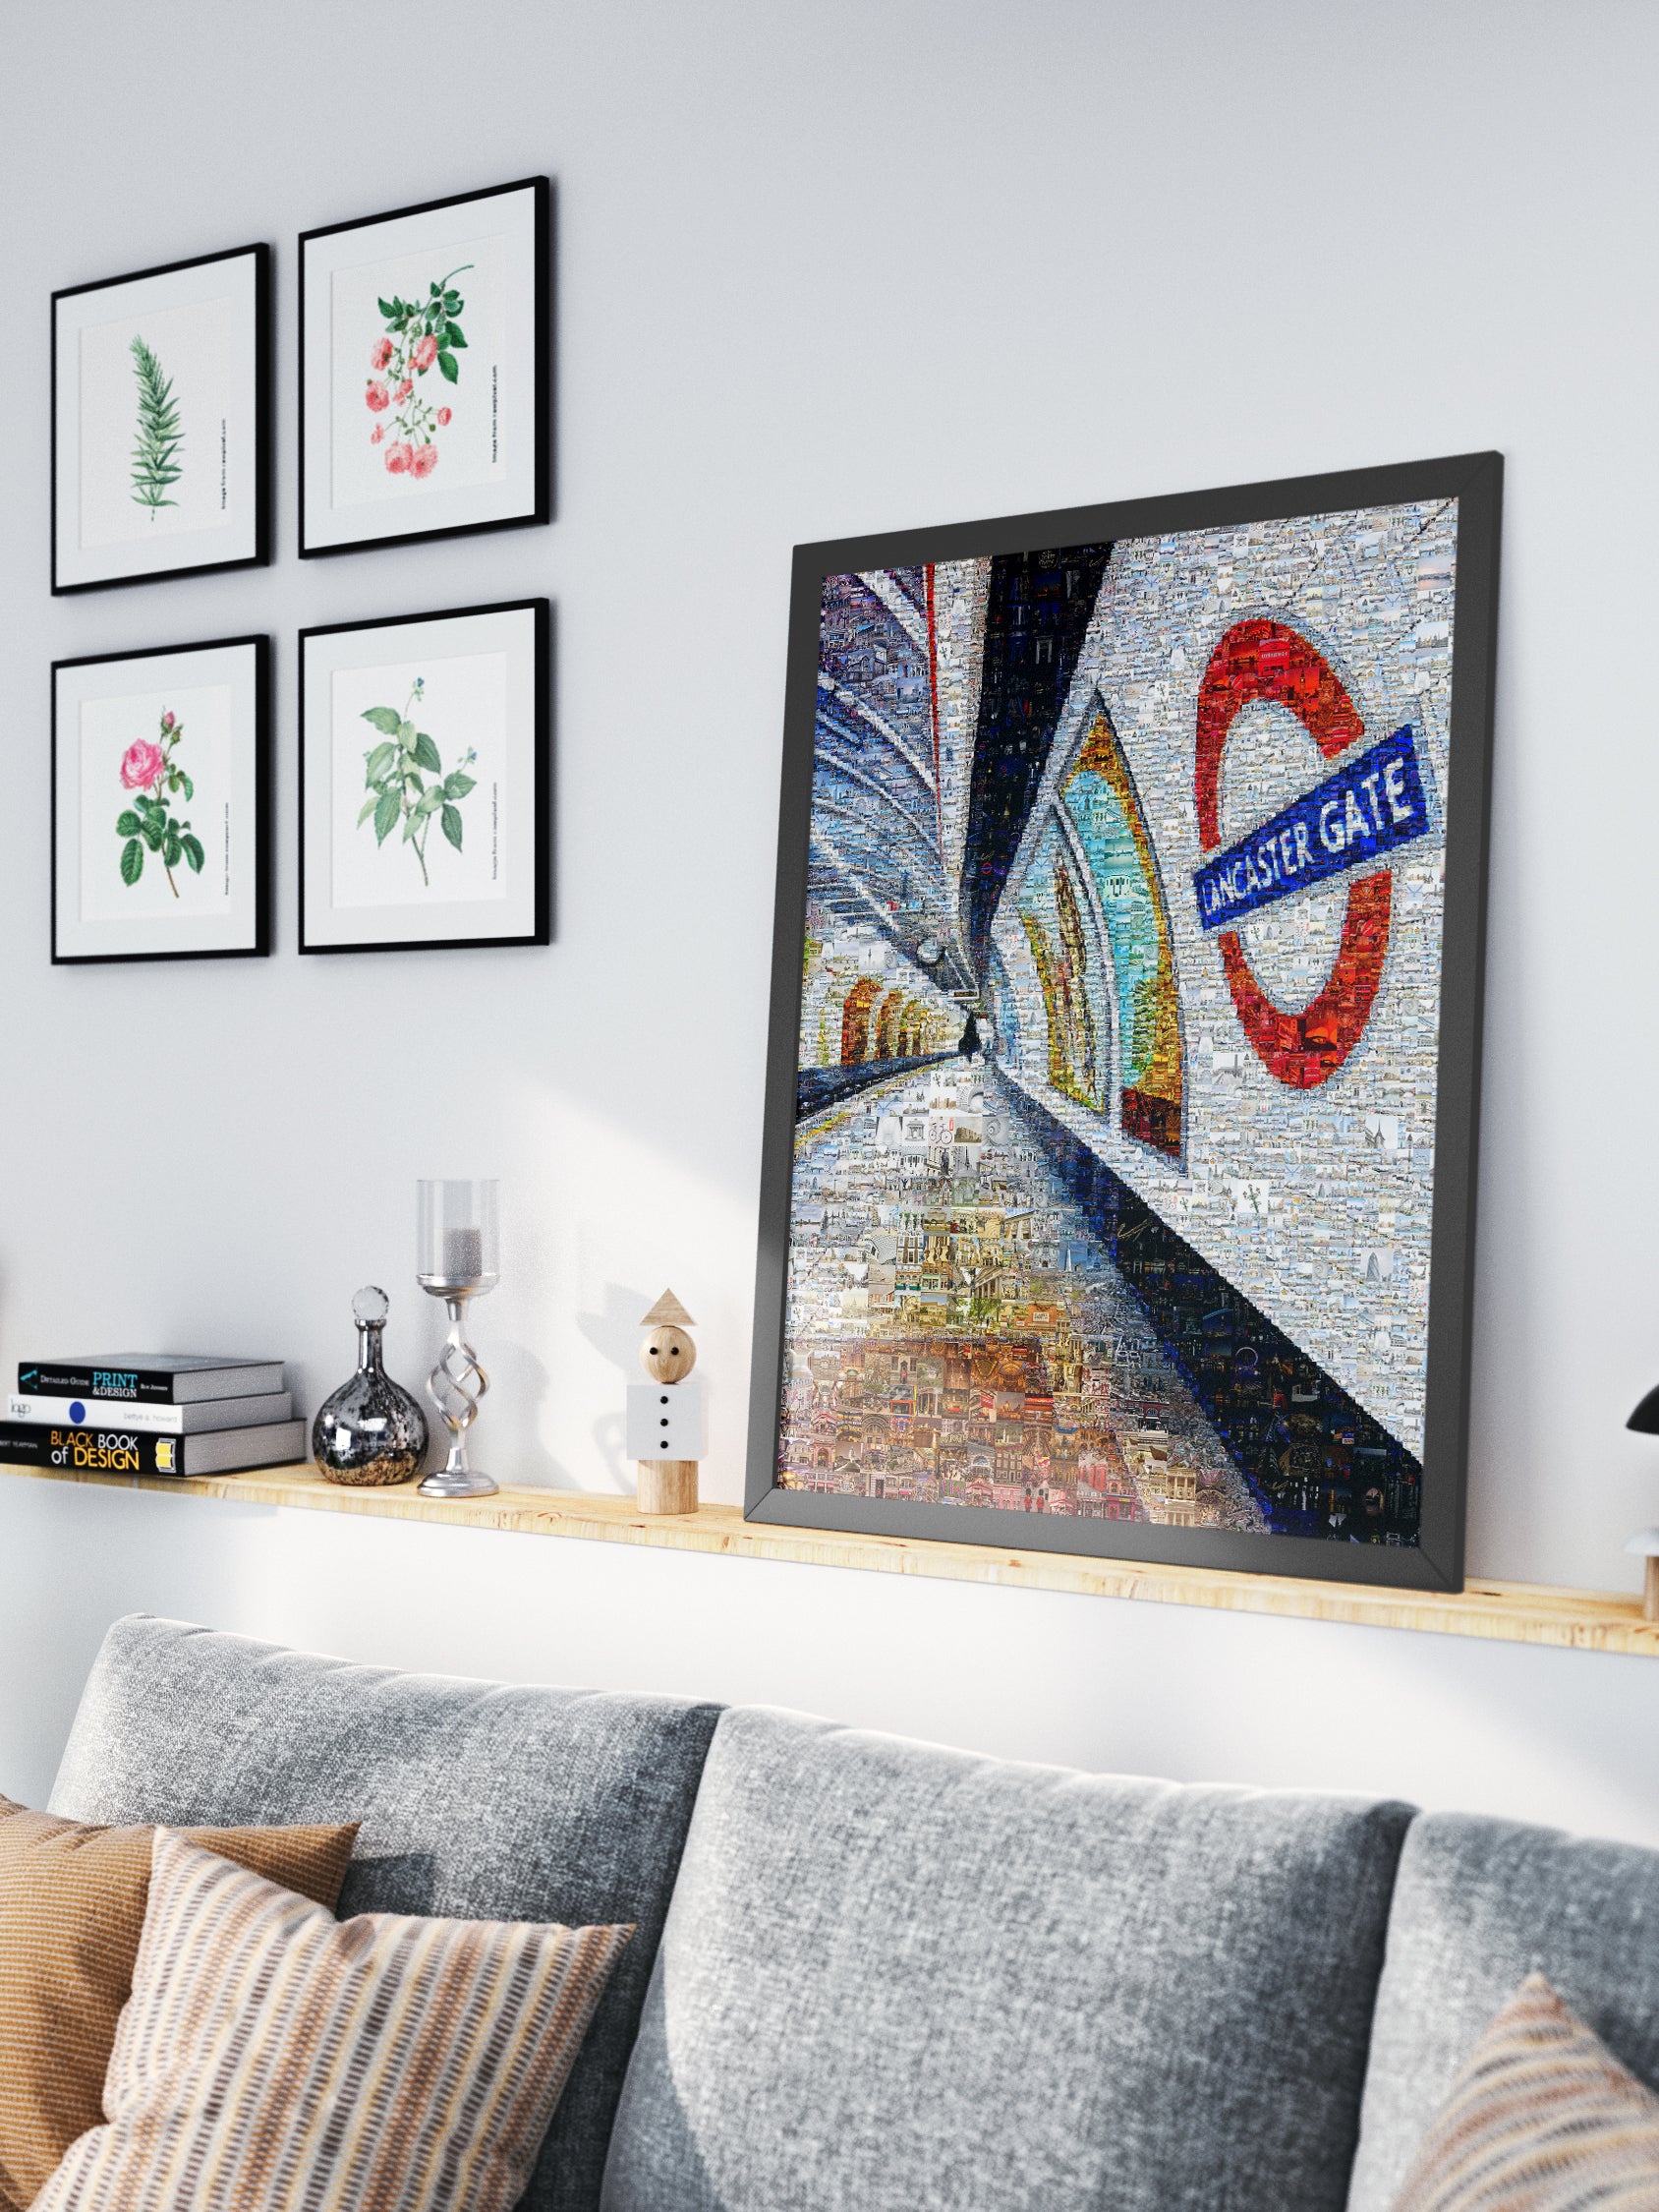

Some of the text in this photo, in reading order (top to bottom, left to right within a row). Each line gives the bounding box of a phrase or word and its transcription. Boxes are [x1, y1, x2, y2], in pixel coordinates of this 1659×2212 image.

[1319, 756, 1415, 854] GATE
[92, 1371, 139, 1389] PRINT
[91, 1385, 138, 1398] &DESIGN
[10, 1398, 32, 1419] logo
[50, 1430, 139, 1451] BLACK BOOK
[51, 1446, 141, 1471] of DESIGN
